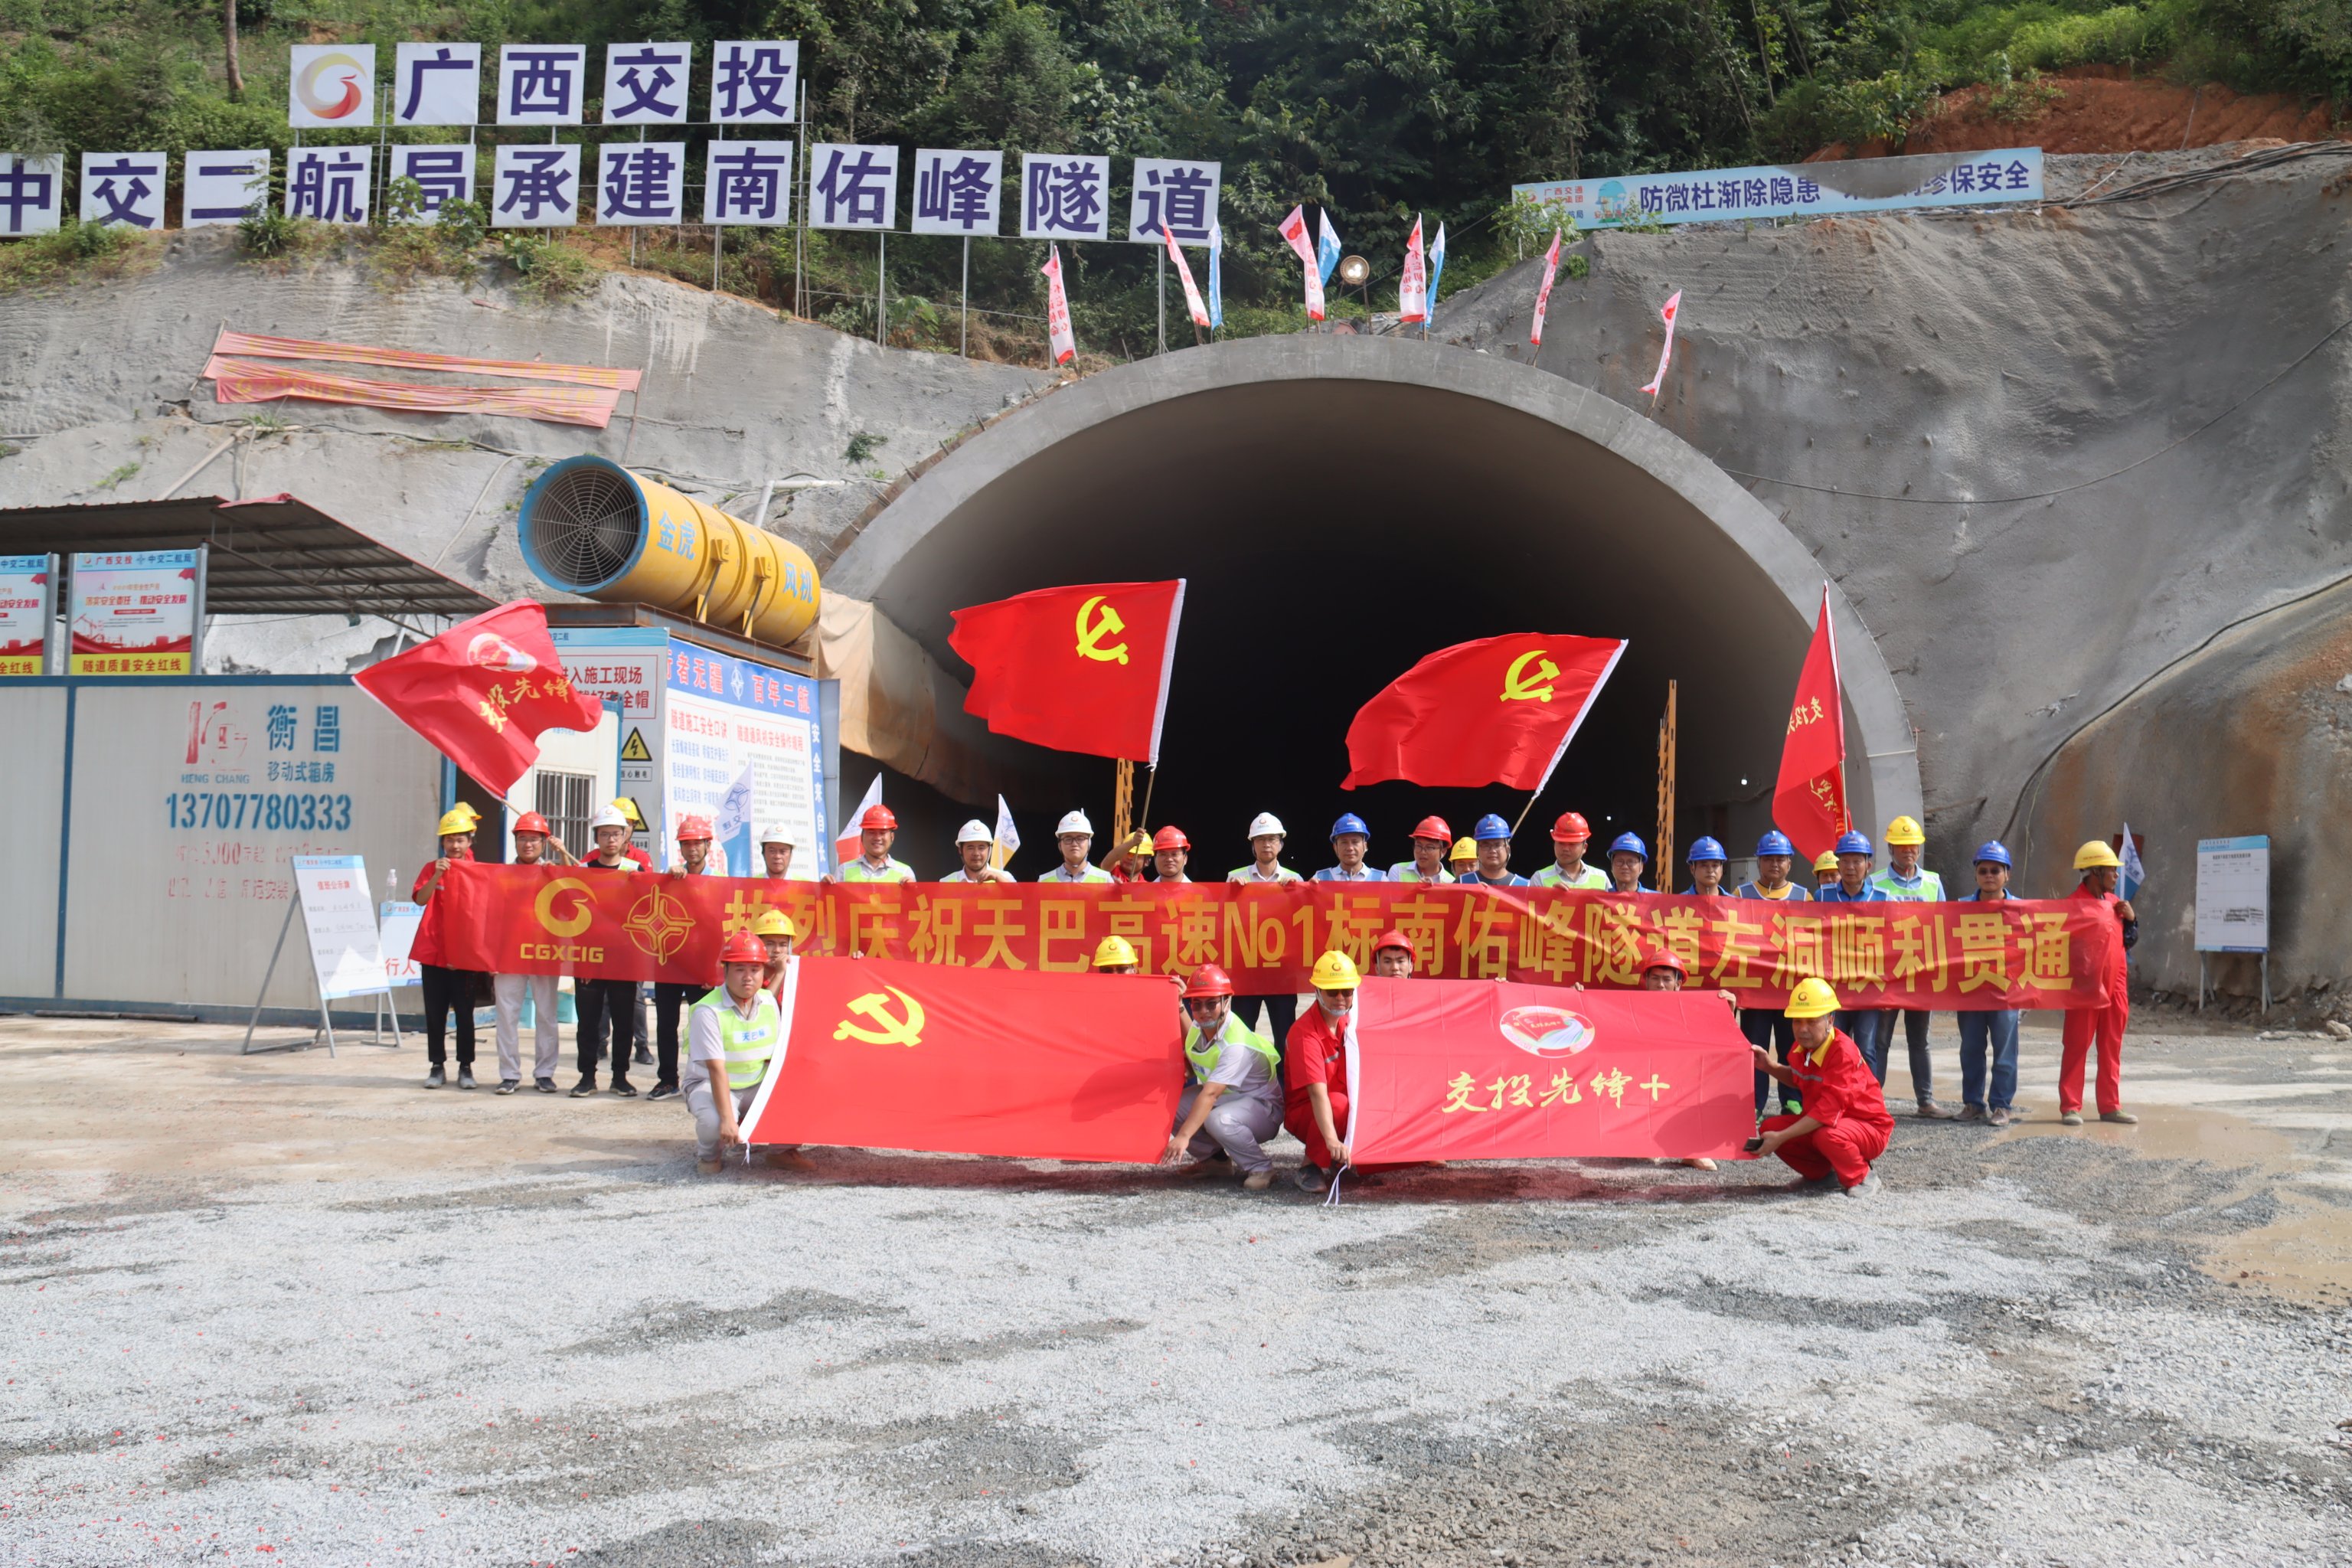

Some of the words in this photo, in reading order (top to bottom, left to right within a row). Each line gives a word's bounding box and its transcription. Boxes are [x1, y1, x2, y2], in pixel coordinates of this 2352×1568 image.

[402, 47, 791, 119] 广西交投
[0, 147, 1212, 239] 中交二航局承建南佑峰隧道
[1544, 186, 1583, 196] 广西交通
[1641, 176, 1821, 214] 防微杜渐除隐患
[95, 556, 132, 565] 广西交投
[657, 511, 696, 560] 金虎
[783, 561, 814, 603] 风机
[83, 658, 181, 672] 隧道质量安全红线
[752, 675, 811, 714] 百年二航
[267, 704, 340, 752] 衡昌
[181, 774, 209, 784] HENG
[215, 774, 250, 784] CHANG
[267, 761, 335, 783] 移动式箱房
[166, 792, 351, 831] 13707780333
[520, 942, 604, 963] CGXCIG
